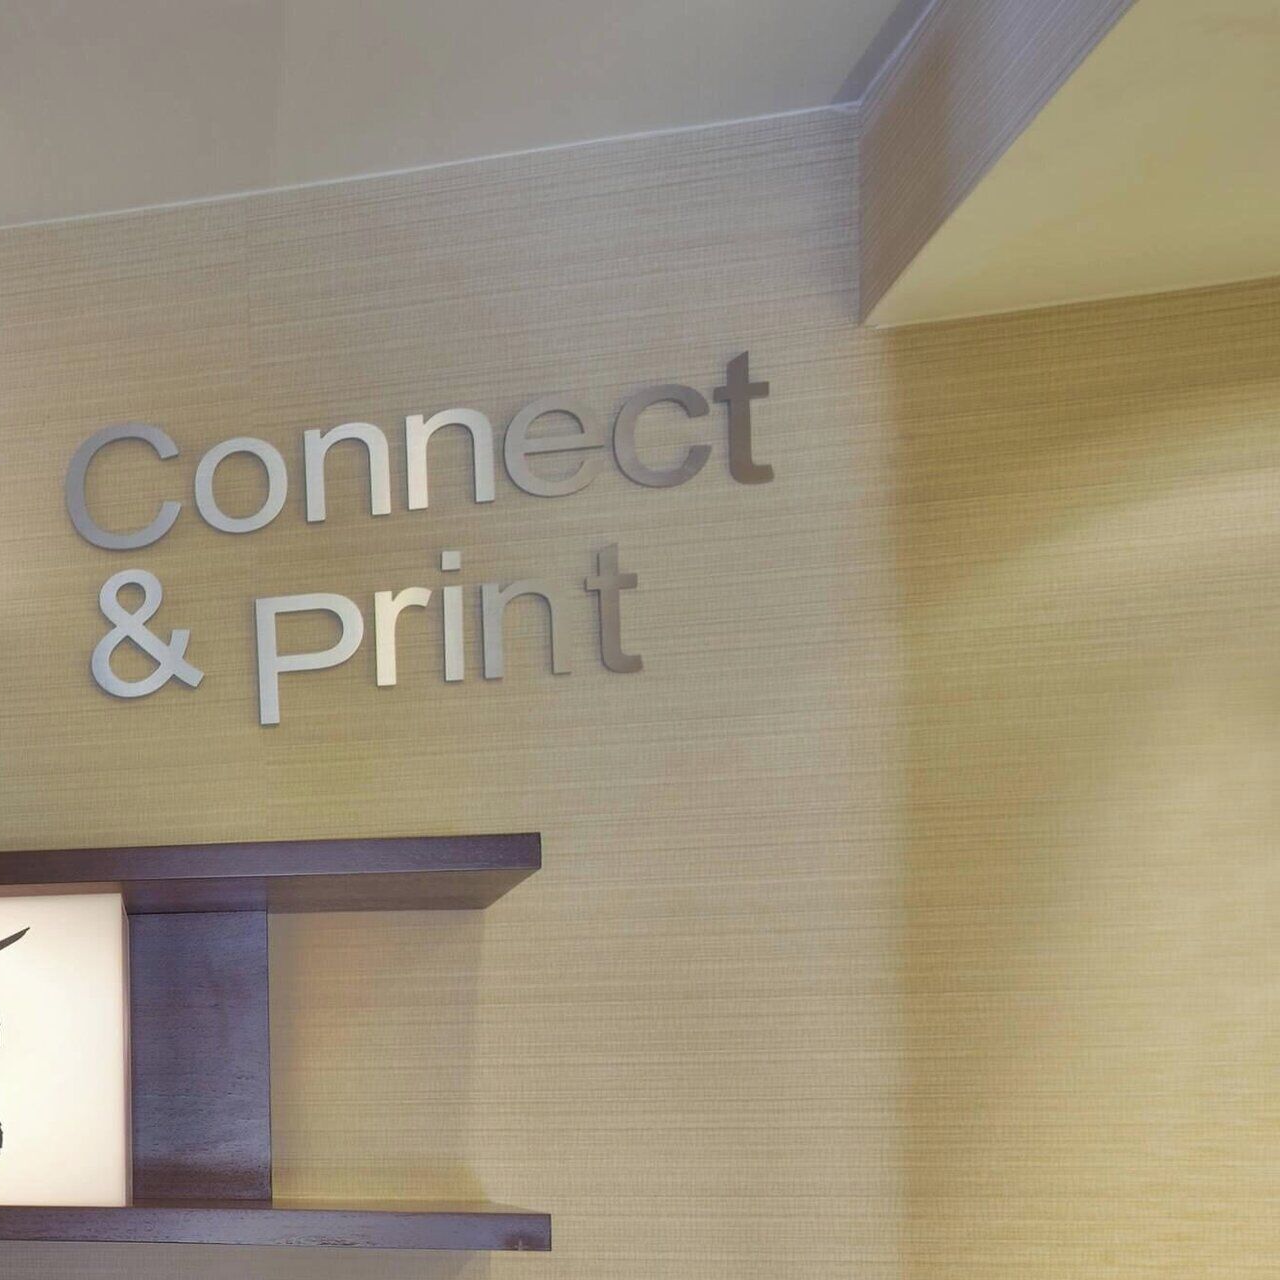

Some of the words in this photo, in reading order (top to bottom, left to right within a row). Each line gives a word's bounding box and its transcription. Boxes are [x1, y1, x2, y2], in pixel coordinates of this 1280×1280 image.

[65, 350, 775, 550] Connect
[91, 569, 204, 697] &
[255, 543, 644, 725] Print
